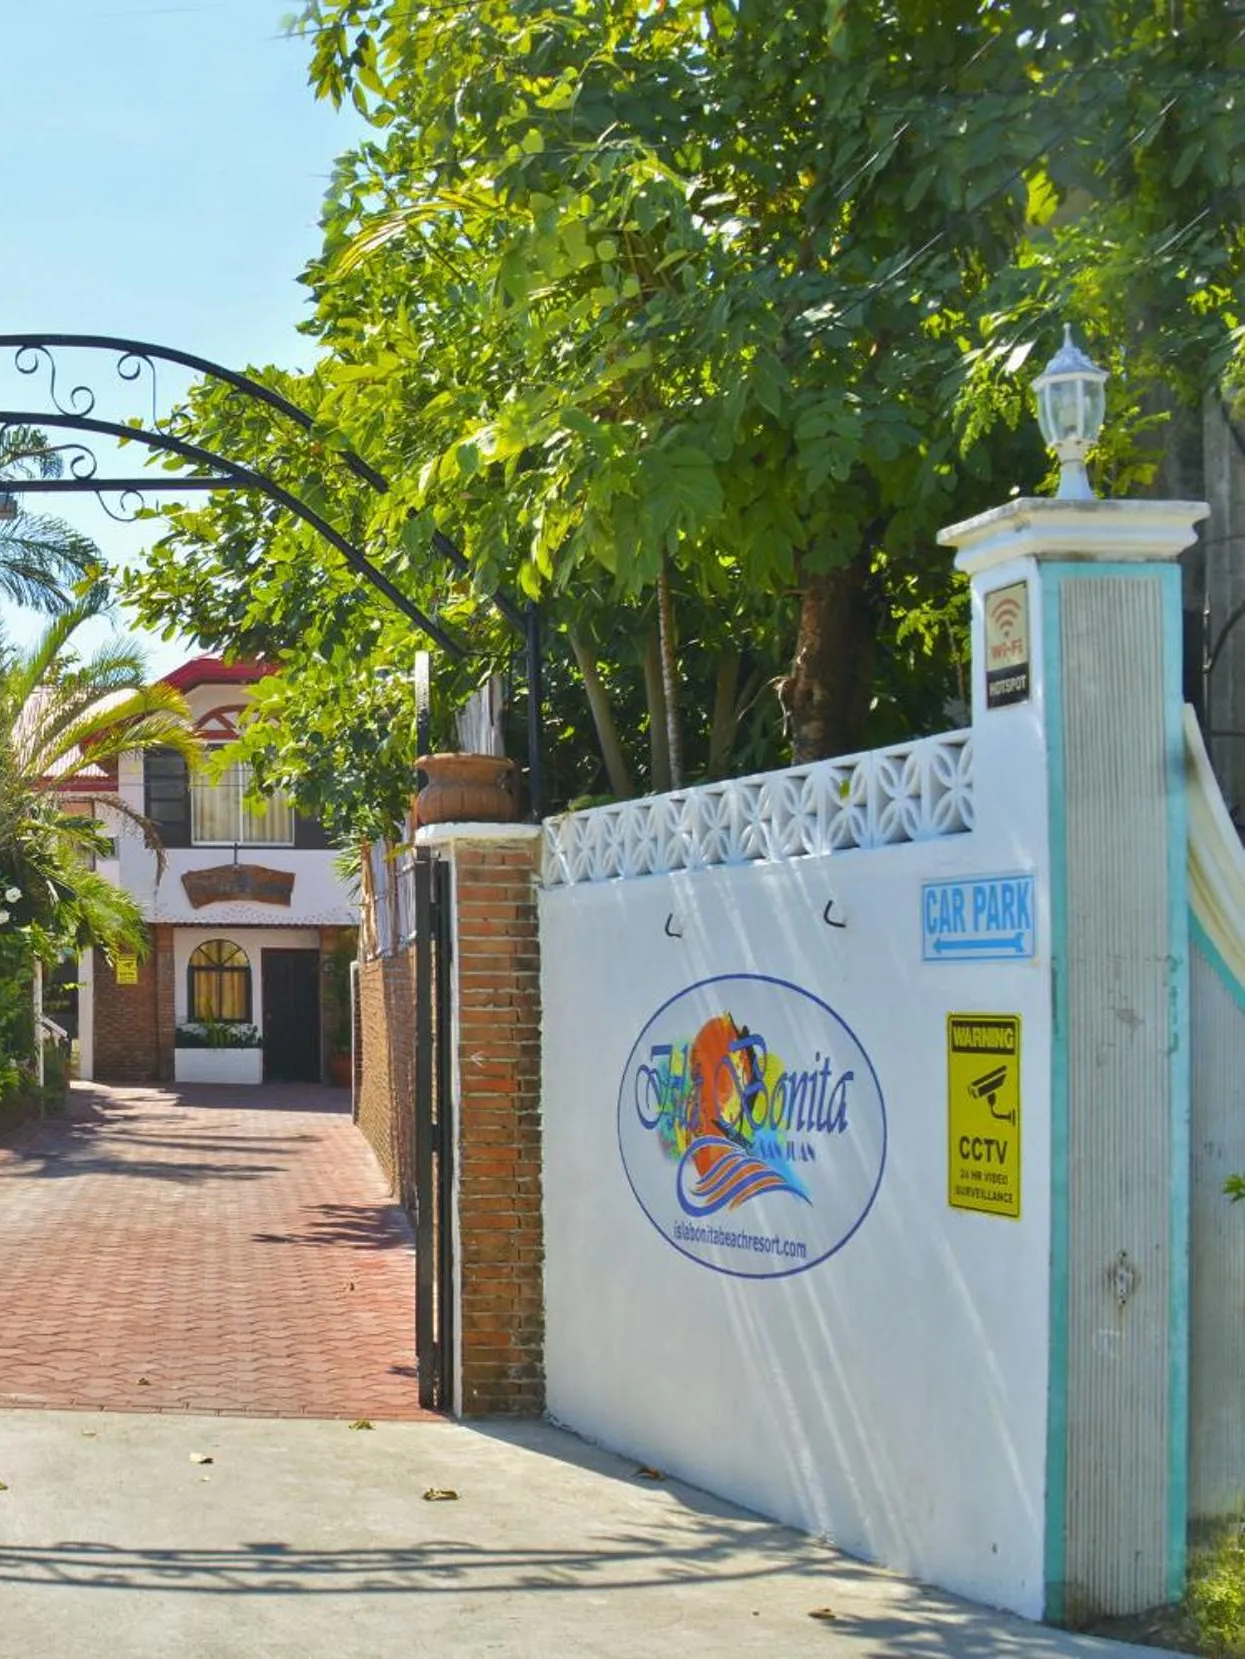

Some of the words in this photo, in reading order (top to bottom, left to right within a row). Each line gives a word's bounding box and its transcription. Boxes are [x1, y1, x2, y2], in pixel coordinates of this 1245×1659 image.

[925, 887, 966, 935] CAR
[973, 881, 1031, 931] PARK
[953, 1025, 1014, 1049] WARNING
[714, 1034, 854, 1134] Bonita
[959, 1135, 1008, 1165] CCTV
[984, 1171, 1008, 1185] VIDEO
[955, 1185, 1013, 1204] SURVEILLANCE
[674, 1220, 807, 1259] islabonitabeachresort.com
